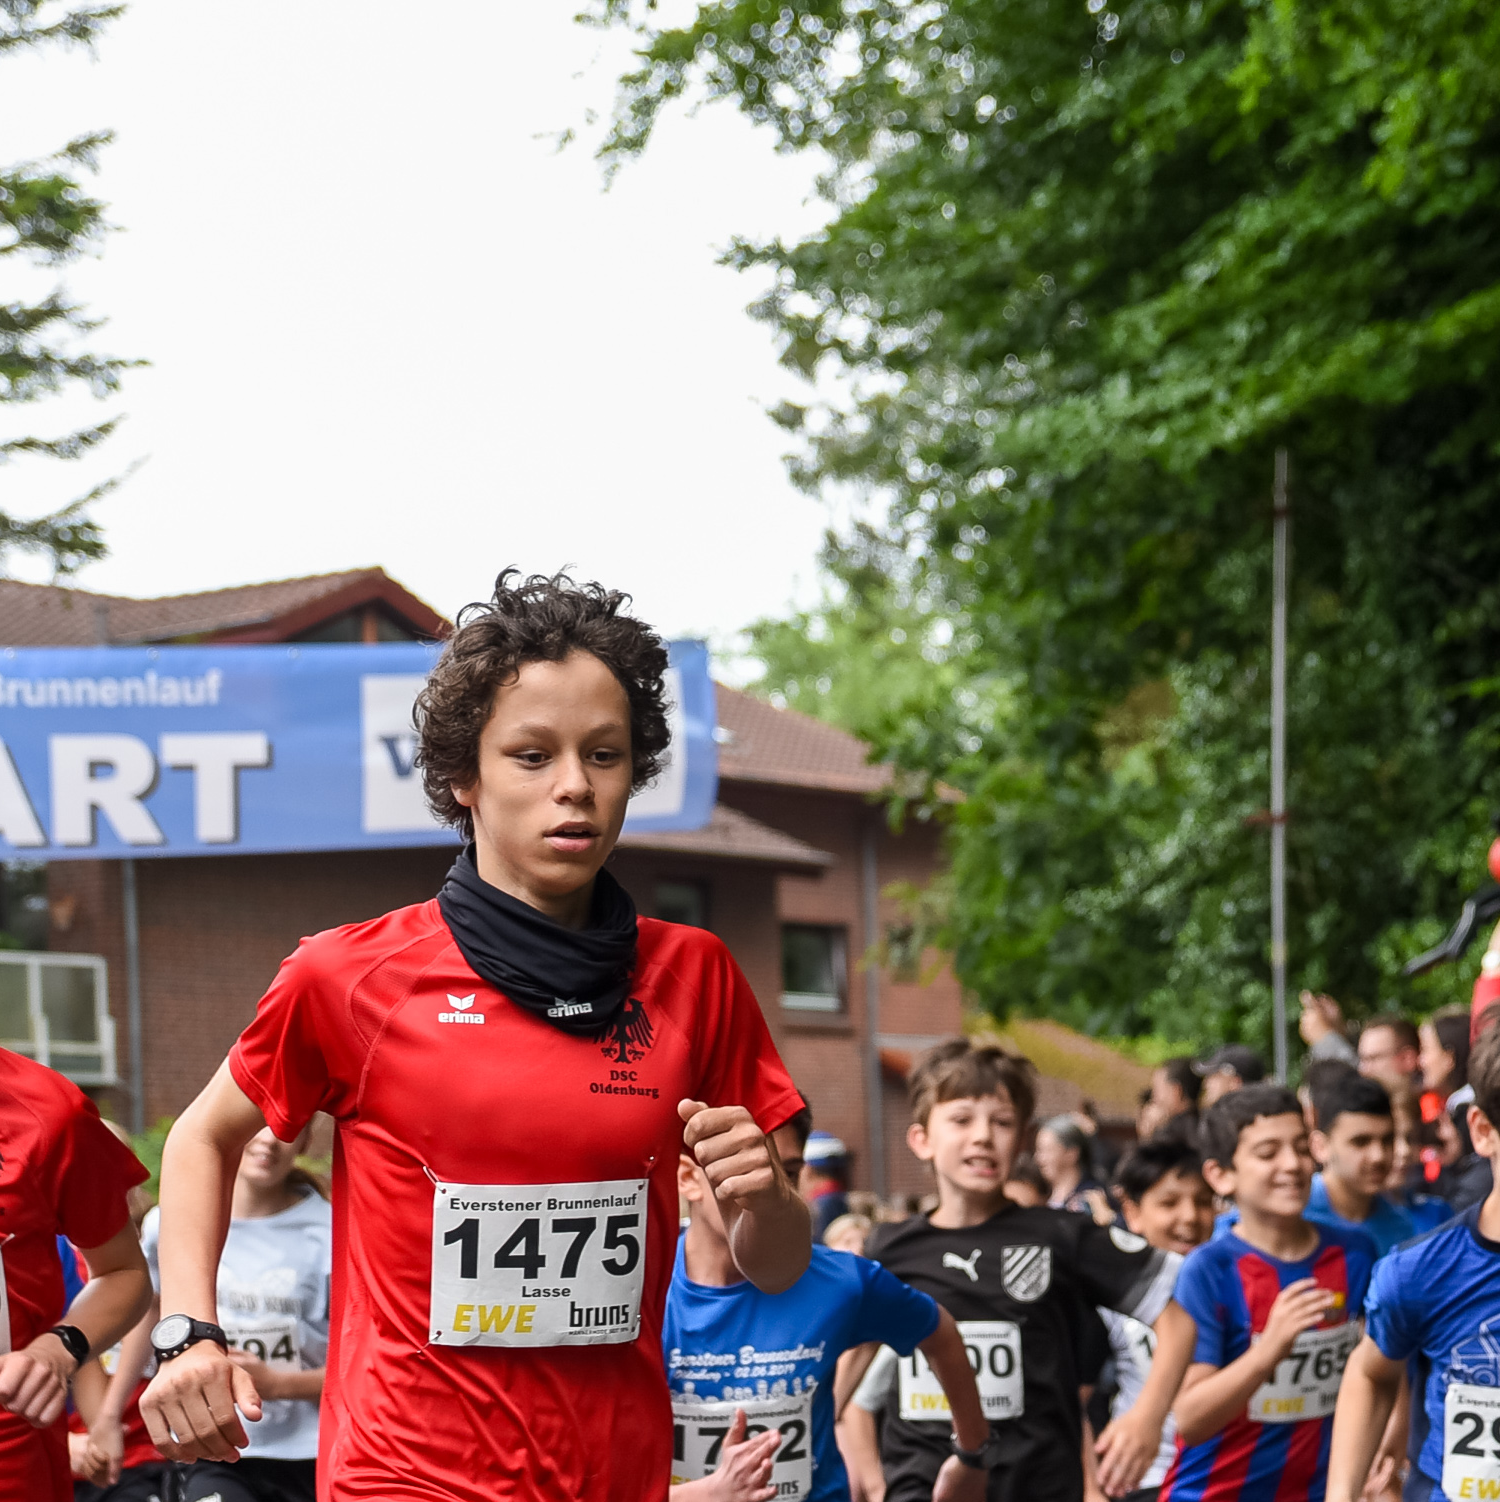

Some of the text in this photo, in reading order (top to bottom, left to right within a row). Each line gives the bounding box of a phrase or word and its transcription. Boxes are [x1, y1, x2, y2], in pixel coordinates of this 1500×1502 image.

[547, 1002, 593, 1017] erima
[438, 1011, 485, 1024] erima
[610, 1070, 638, 1081] DSC
[590, 1083, 659, 1099] Oldenburg
[450, 1193, 637, 1211] Everstener Brunnenlauf
[444, 1213, 640, 1279] 1475
[522, 1286, 571, 1298] Lasse
[453, 1301, 629, 1333] EWE bruns
[674, 1412, 730, 1422] verstener
